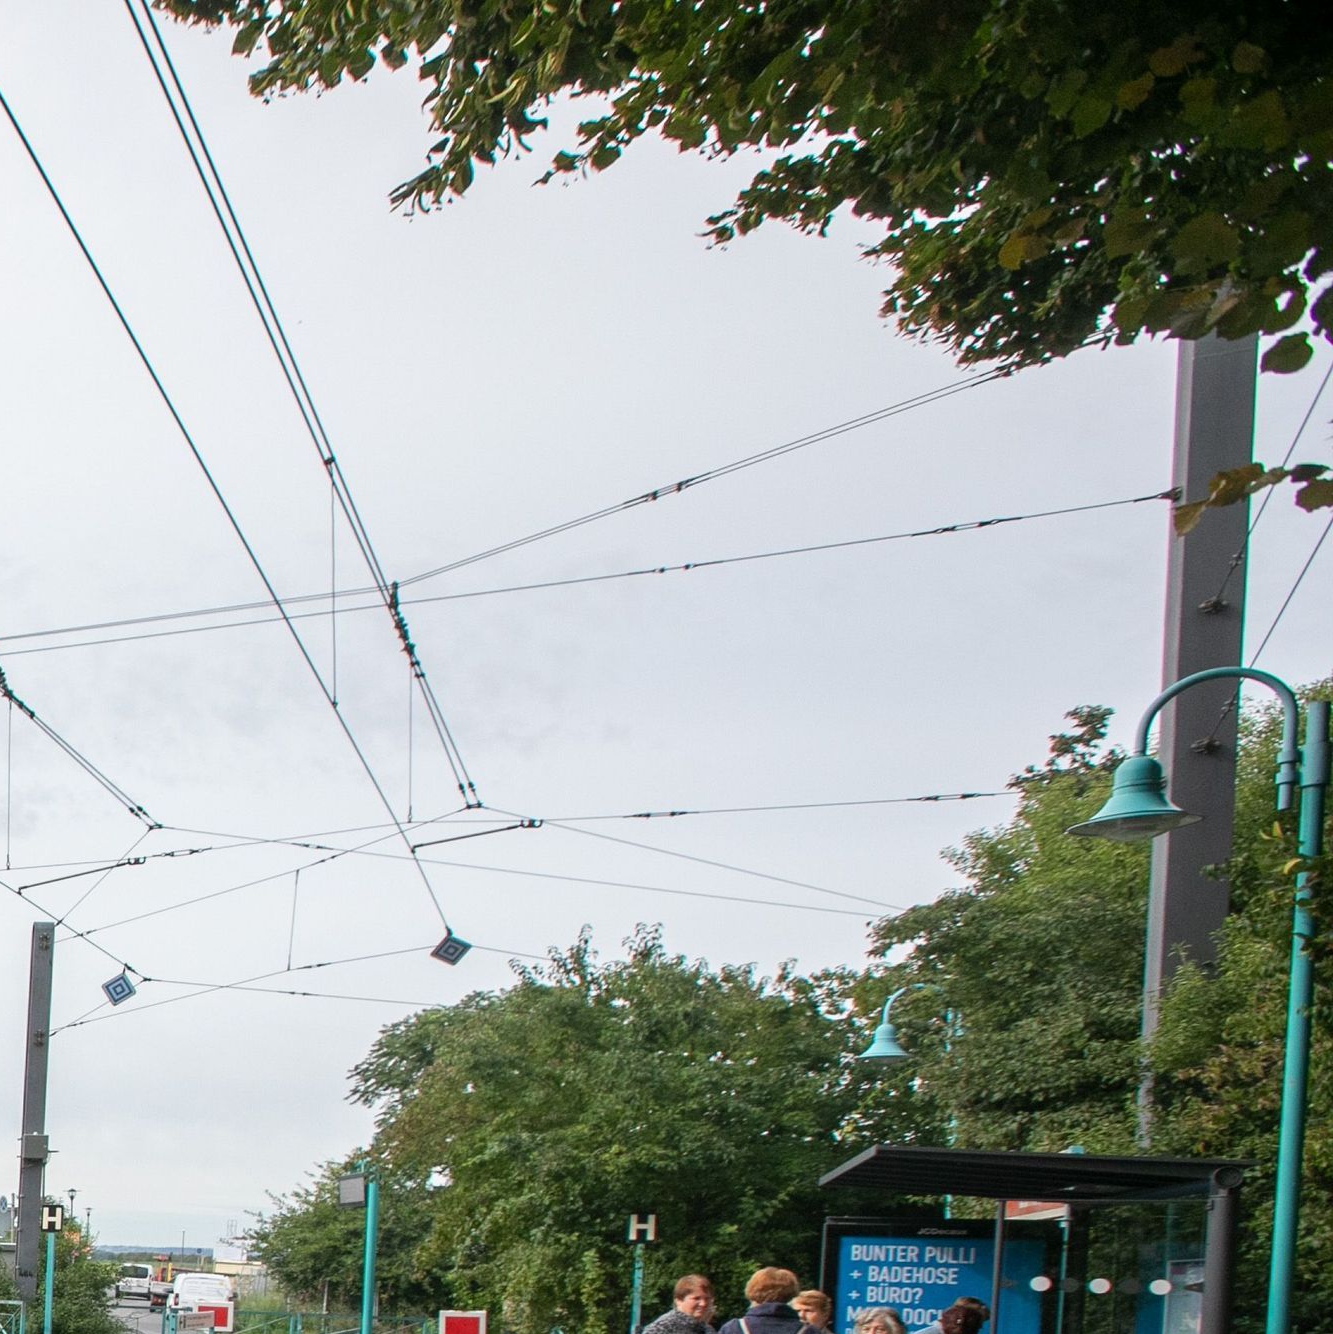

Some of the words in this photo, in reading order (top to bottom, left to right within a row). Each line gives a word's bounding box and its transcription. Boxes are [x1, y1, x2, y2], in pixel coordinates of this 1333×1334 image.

[42, 1207, 62, 1229] H
[629, 1214, 656, 1241] H
[851, 1244, 918, 1263] BUNTER
[925, 1248, 976, 1264] PULLI
[868, 1266, 959, 1285] BADEHOSE
[867, 1283, 923, 1304] BÜRO?
